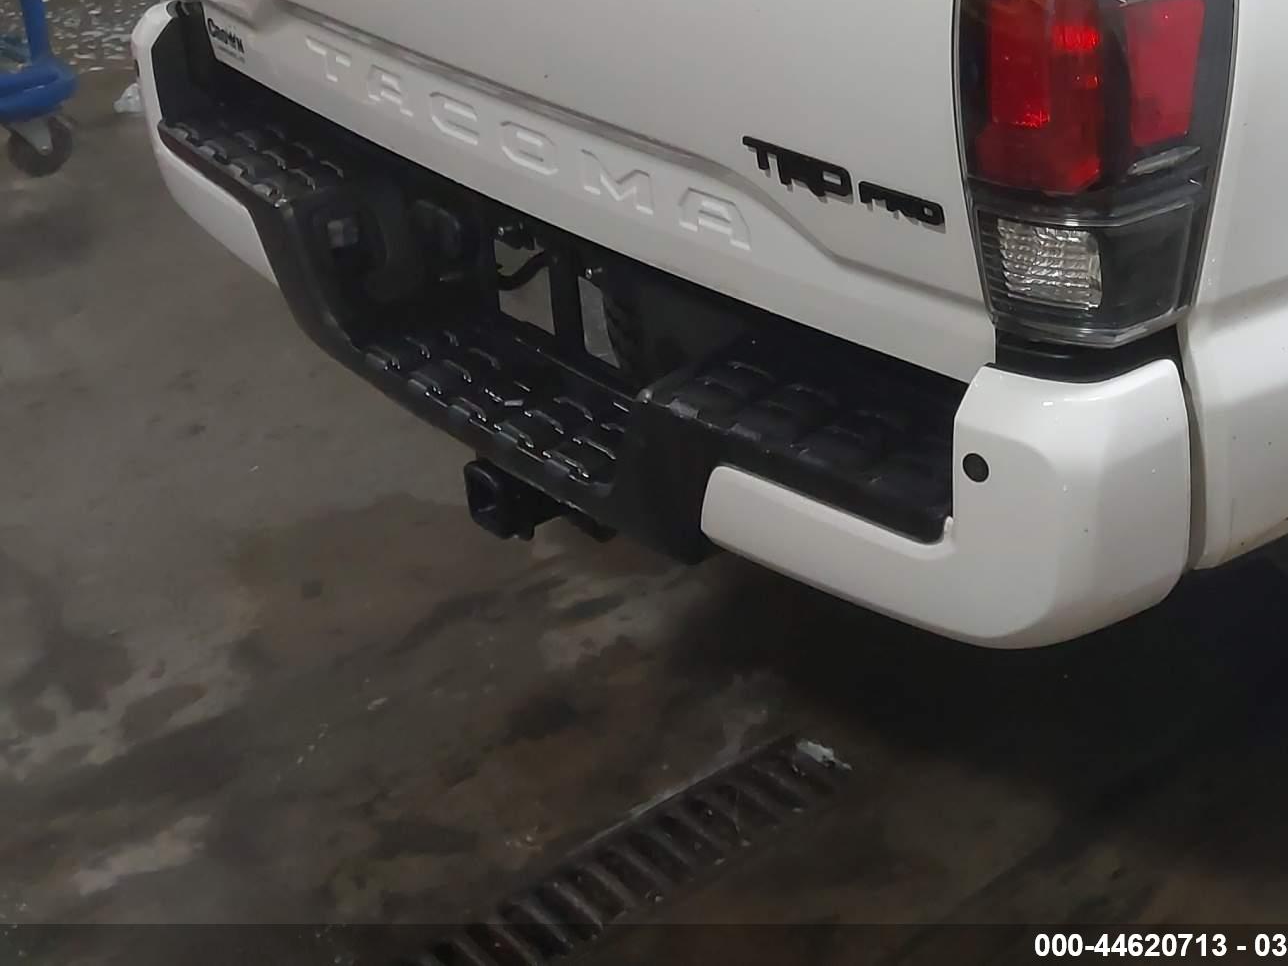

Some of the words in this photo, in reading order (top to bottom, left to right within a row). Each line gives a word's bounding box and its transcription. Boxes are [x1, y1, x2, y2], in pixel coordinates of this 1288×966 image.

[304, 36, 751, 251] TACOMA
[742, 135, 854, 201] TRD
[858, 180, 946, 229] PRO
